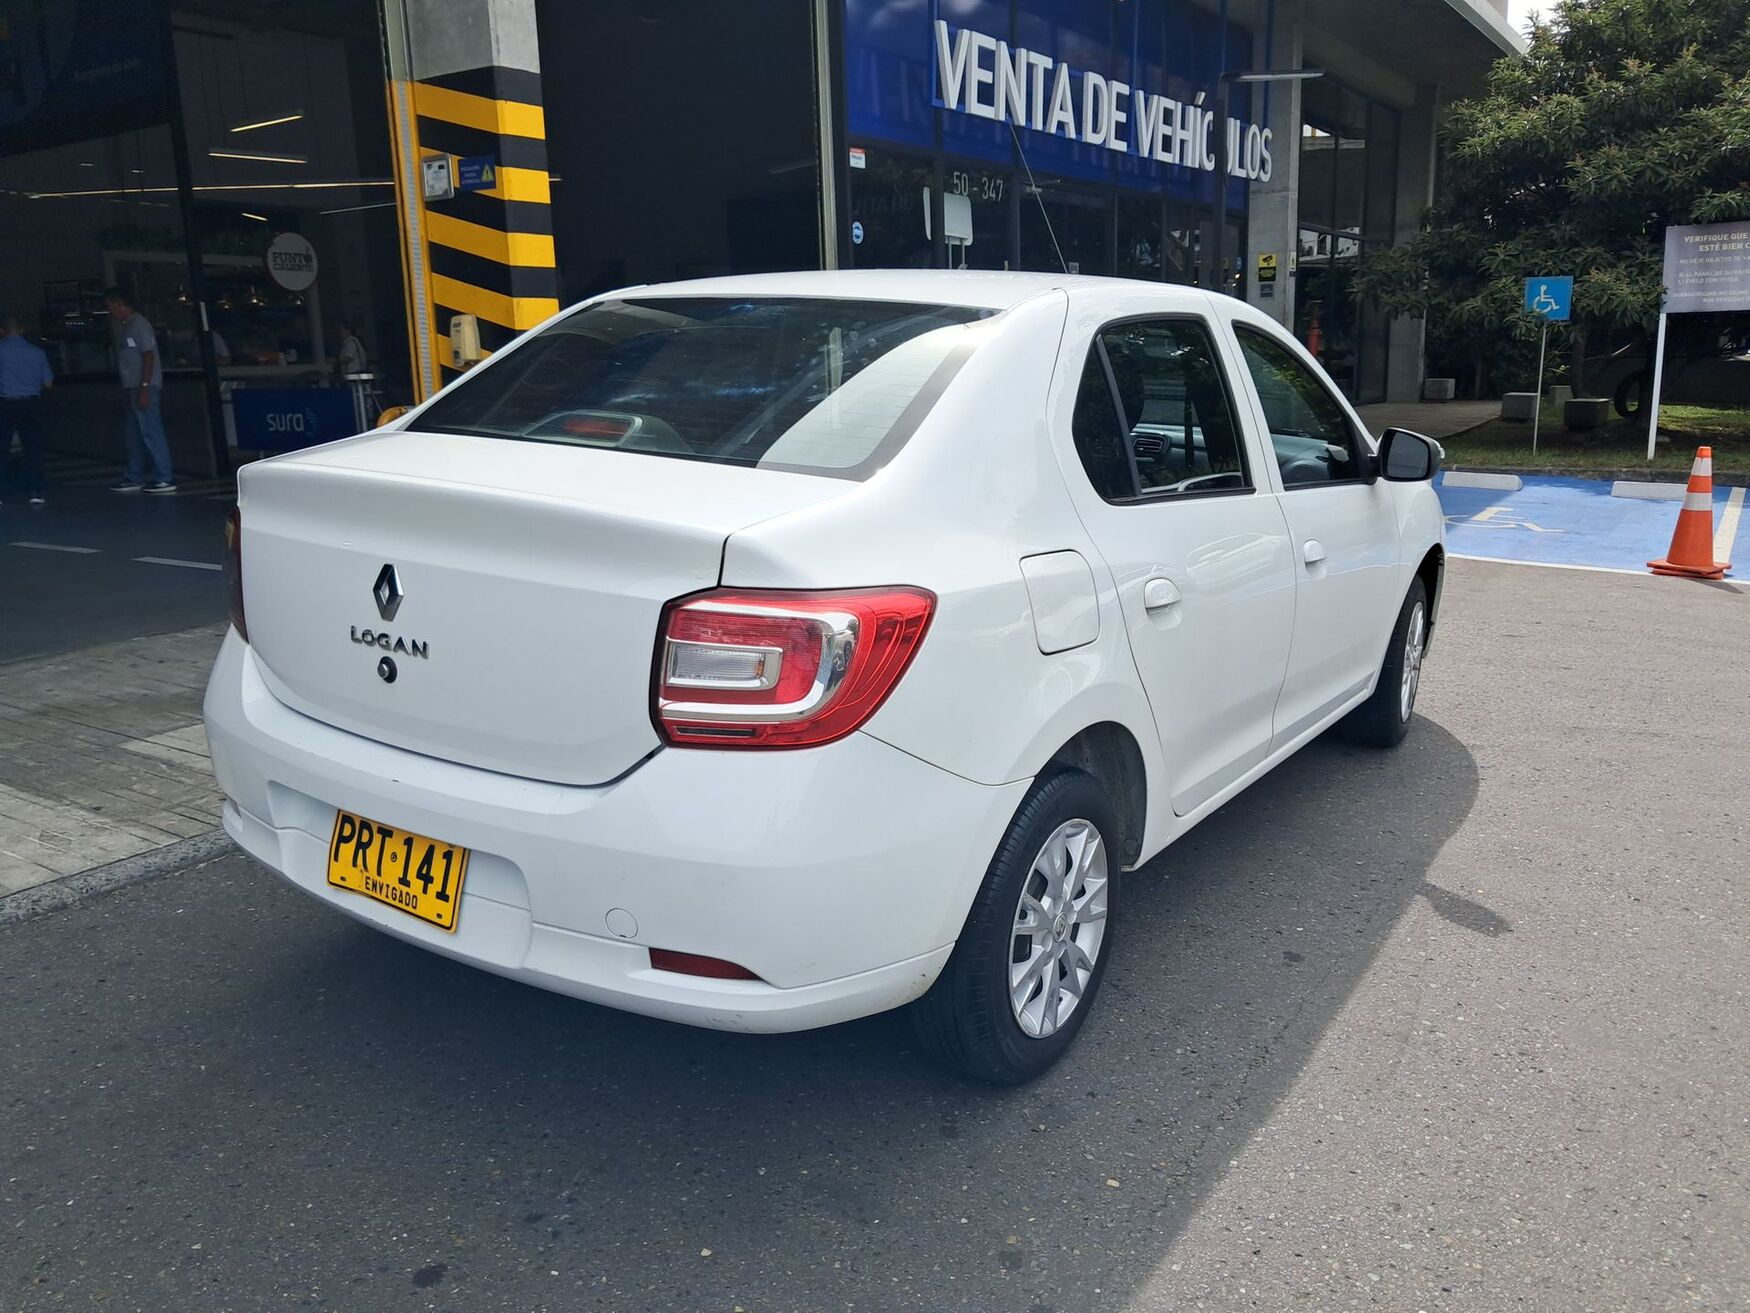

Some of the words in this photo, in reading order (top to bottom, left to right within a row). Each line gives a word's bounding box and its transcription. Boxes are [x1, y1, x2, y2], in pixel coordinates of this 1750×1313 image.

[934, 19, 1077, 140] VENTA
[1082, 70, 1131, 153] DE
[953, 171, 969, 196] 50
[981, 176, 1004, 202] 347
[1684, 233, 1729, 243] VERIFIQUE
[1730, 232, 1749, 240] QUE
[1699, 242, 1720, 252] ESTÉ
[1722, 242, 1743, 251] BIEN
[266, 413, 305, 432] sura
[351, 625, 429, 659] LOGAN
[333, 813, 394, 877] PRT
[398, 836, 454, 903] 141
[364, 875, 418, 909] ENVIGADO
